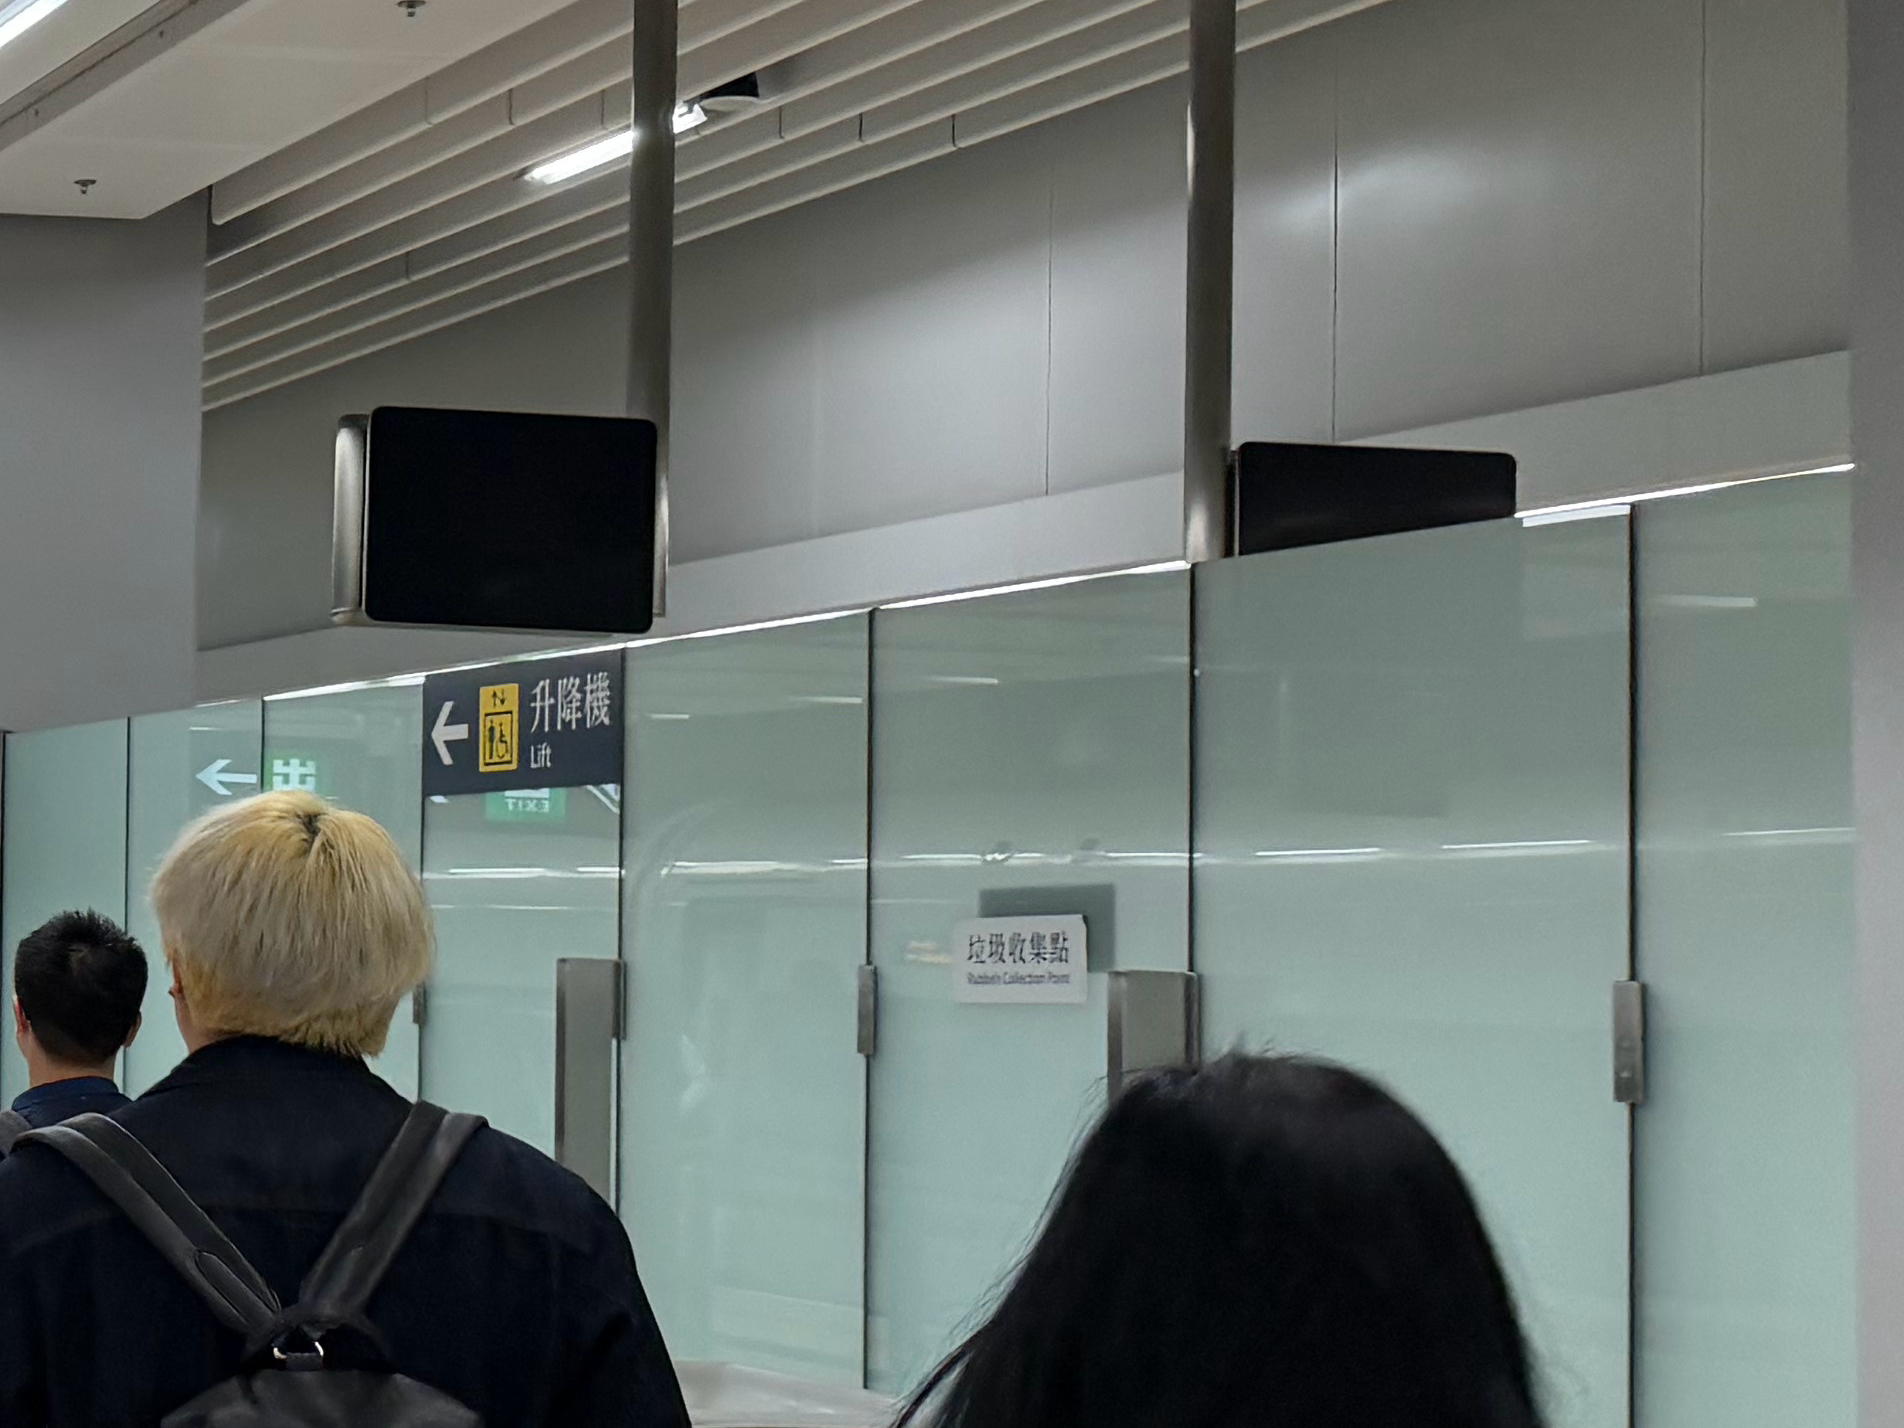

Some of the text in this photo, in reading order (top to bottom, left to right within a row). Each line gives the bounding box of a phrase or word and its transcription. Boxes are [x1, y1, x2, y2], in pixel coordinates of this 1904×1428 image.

[530, 671, 611, 733] 升降機
[530, 742, 552, 768] Lift
[967, 930, 1070, 965] 垃圾收集點
